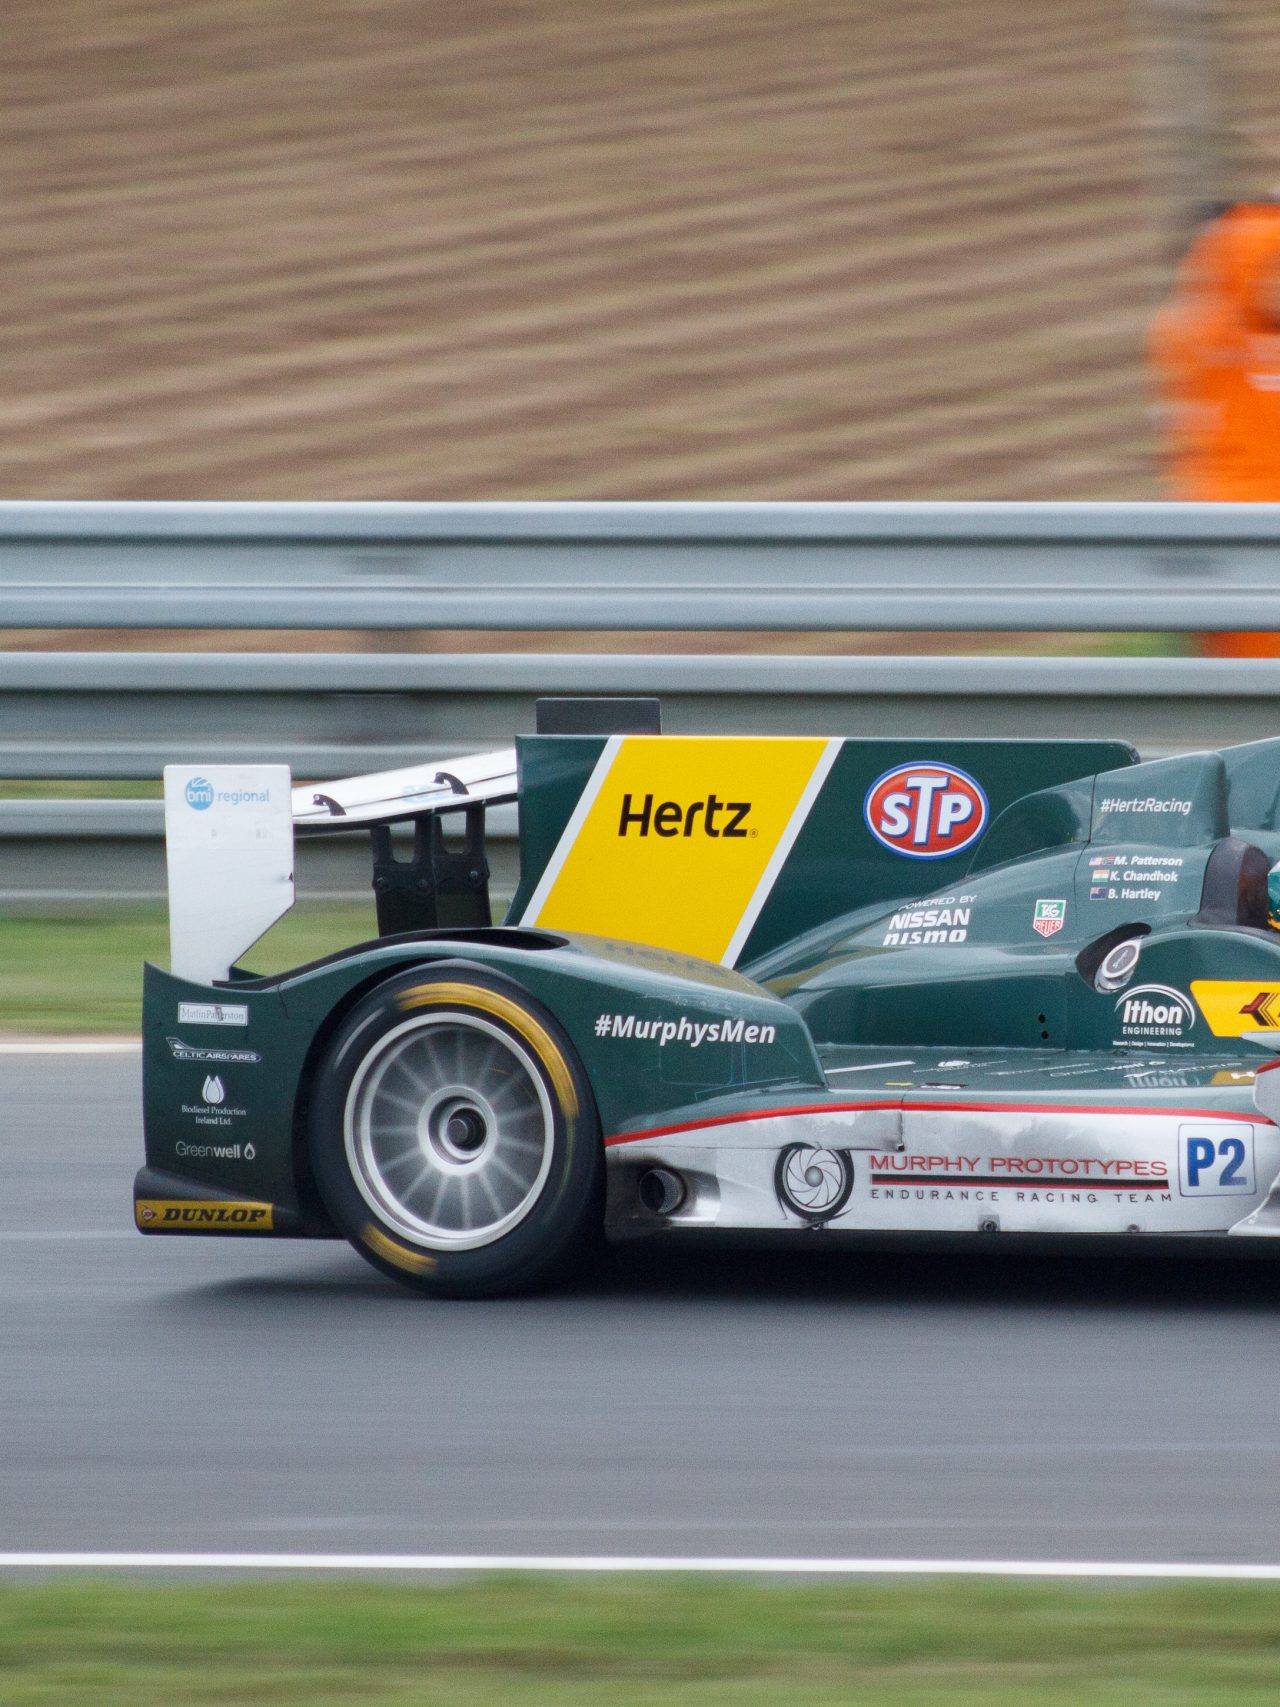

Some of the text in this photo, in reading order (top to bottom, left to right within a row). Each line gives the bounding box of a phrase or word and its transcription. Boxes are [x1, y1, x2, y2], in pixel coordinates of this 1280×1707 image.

[187, 788, 270, 805] bmi regional
[880, 775, 975, 846] STP
[1100, 798, 1192, 815] #HertzRacing
[1113, 856, 1183, 867] M. Patterson
[1109, 870, 1178, 882] K. Chandhok
[1108, 888, 1161, 901] B. Hartley
[898, 895, 978, 911] POWERED BY
[1040, 904, 1060, 917] TAG
[889, 908, 971, 930] NISSAN
[1034, 919, 1061, 934] HEUER
[882, 930, 967, 946] nismo
[1122, 1000, 1182, 1024] Ithon
[594, 1014, 776, 1047] #MurphysMen
[1122, 1026, 1183, 1036] ENGINEERING
[181, 1104, 247, 1116] Biodiesel Production
[195, 1116, 233, 1125] Ireland Ltd.
[175, 1140, 241, 1159] Greenwell
[870, 1155, 1168, 1176] MURPHY PROTOTYPES
[1186, 1136, 1248, 1187] P2
[870, 1189, 1173, 1203] ENDURANCE RACING TEAM
[162, 1208, 267, 1223] DUNLOP
